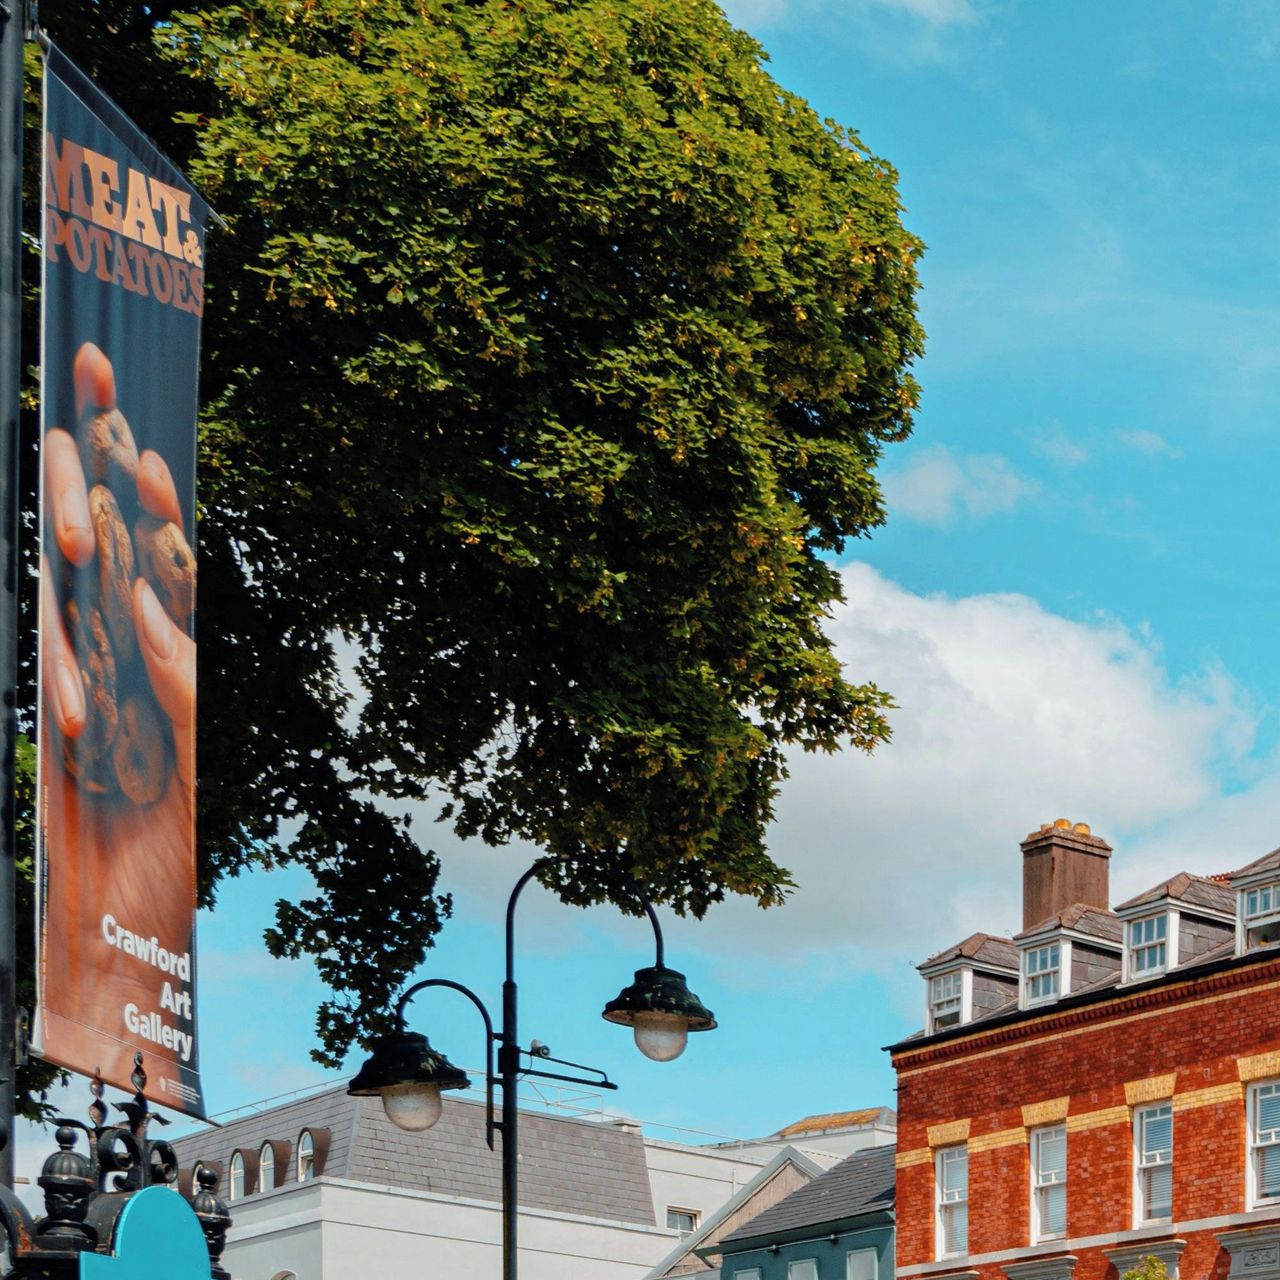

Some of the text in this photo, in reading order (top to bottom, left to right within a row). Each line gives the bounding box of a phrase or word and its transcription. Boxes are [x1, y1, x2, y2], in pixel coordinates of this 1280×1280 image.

[47, 131, 203, 268] MEAT &
[47, 208, 205, 318] POTATOES
[102, 913, 190, 983] Crawford
[124, 1002, 192, 1062] Gallery
[160, 981, 192, 1020] Art
